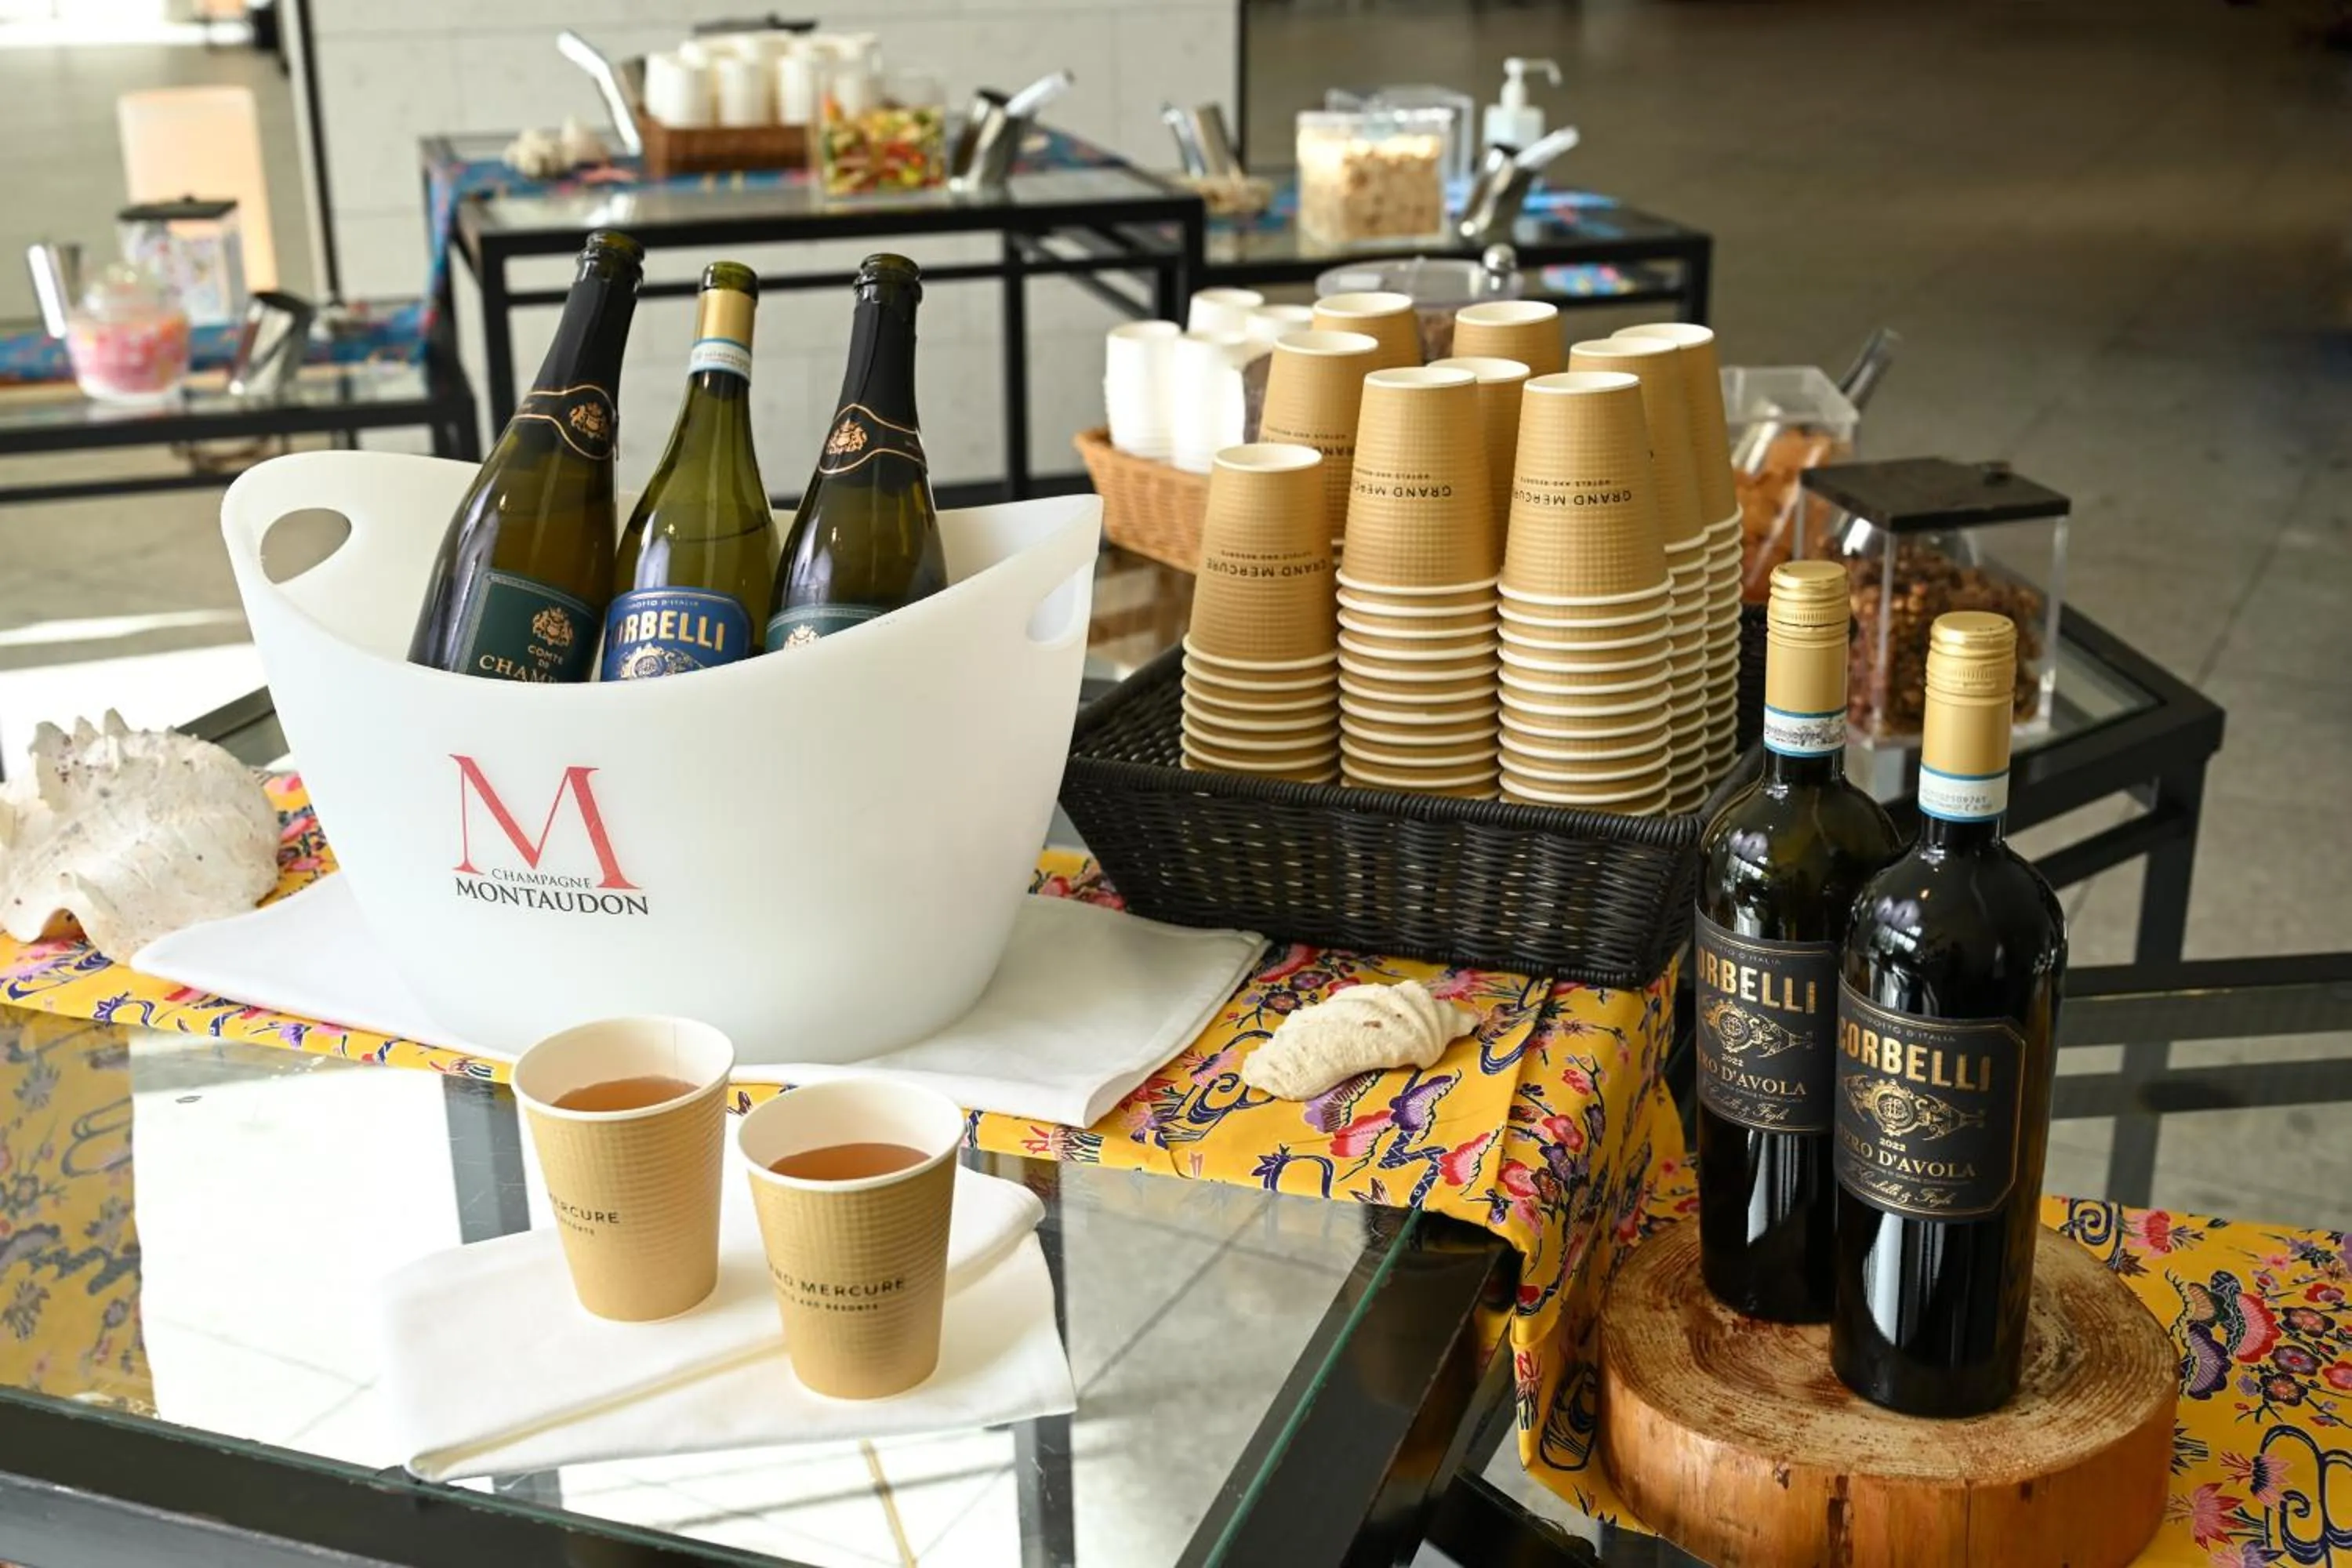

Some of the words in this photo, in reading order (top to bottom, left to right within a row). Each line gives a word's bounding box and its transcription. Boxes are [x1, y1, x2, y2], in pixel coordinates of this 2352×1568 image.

[1354, 481, 1387, 495] MERC
[1393, 485, 1452, 498] GRAND
[1573, 490, 1632, 506] GRAND
[1206, 557, 1275, 578] MERCURE
[1281, 558, 1328, 577] GRAND
[528, 644, 564, 666] COMTE
[448, 753, 642, 890] M
[491, 867, 593, 890] CHAMPAGNE
[455, 877, 650, 916] MONTAUDON
[1697, 946, 1817, 1014] ORBELLI
[1721, 1066, 1807, 1096] D'AVOLA
[1878, 1149, 1976, 1178] D'AVOLA
[800, 1278, 905, 1298] MERCURE
